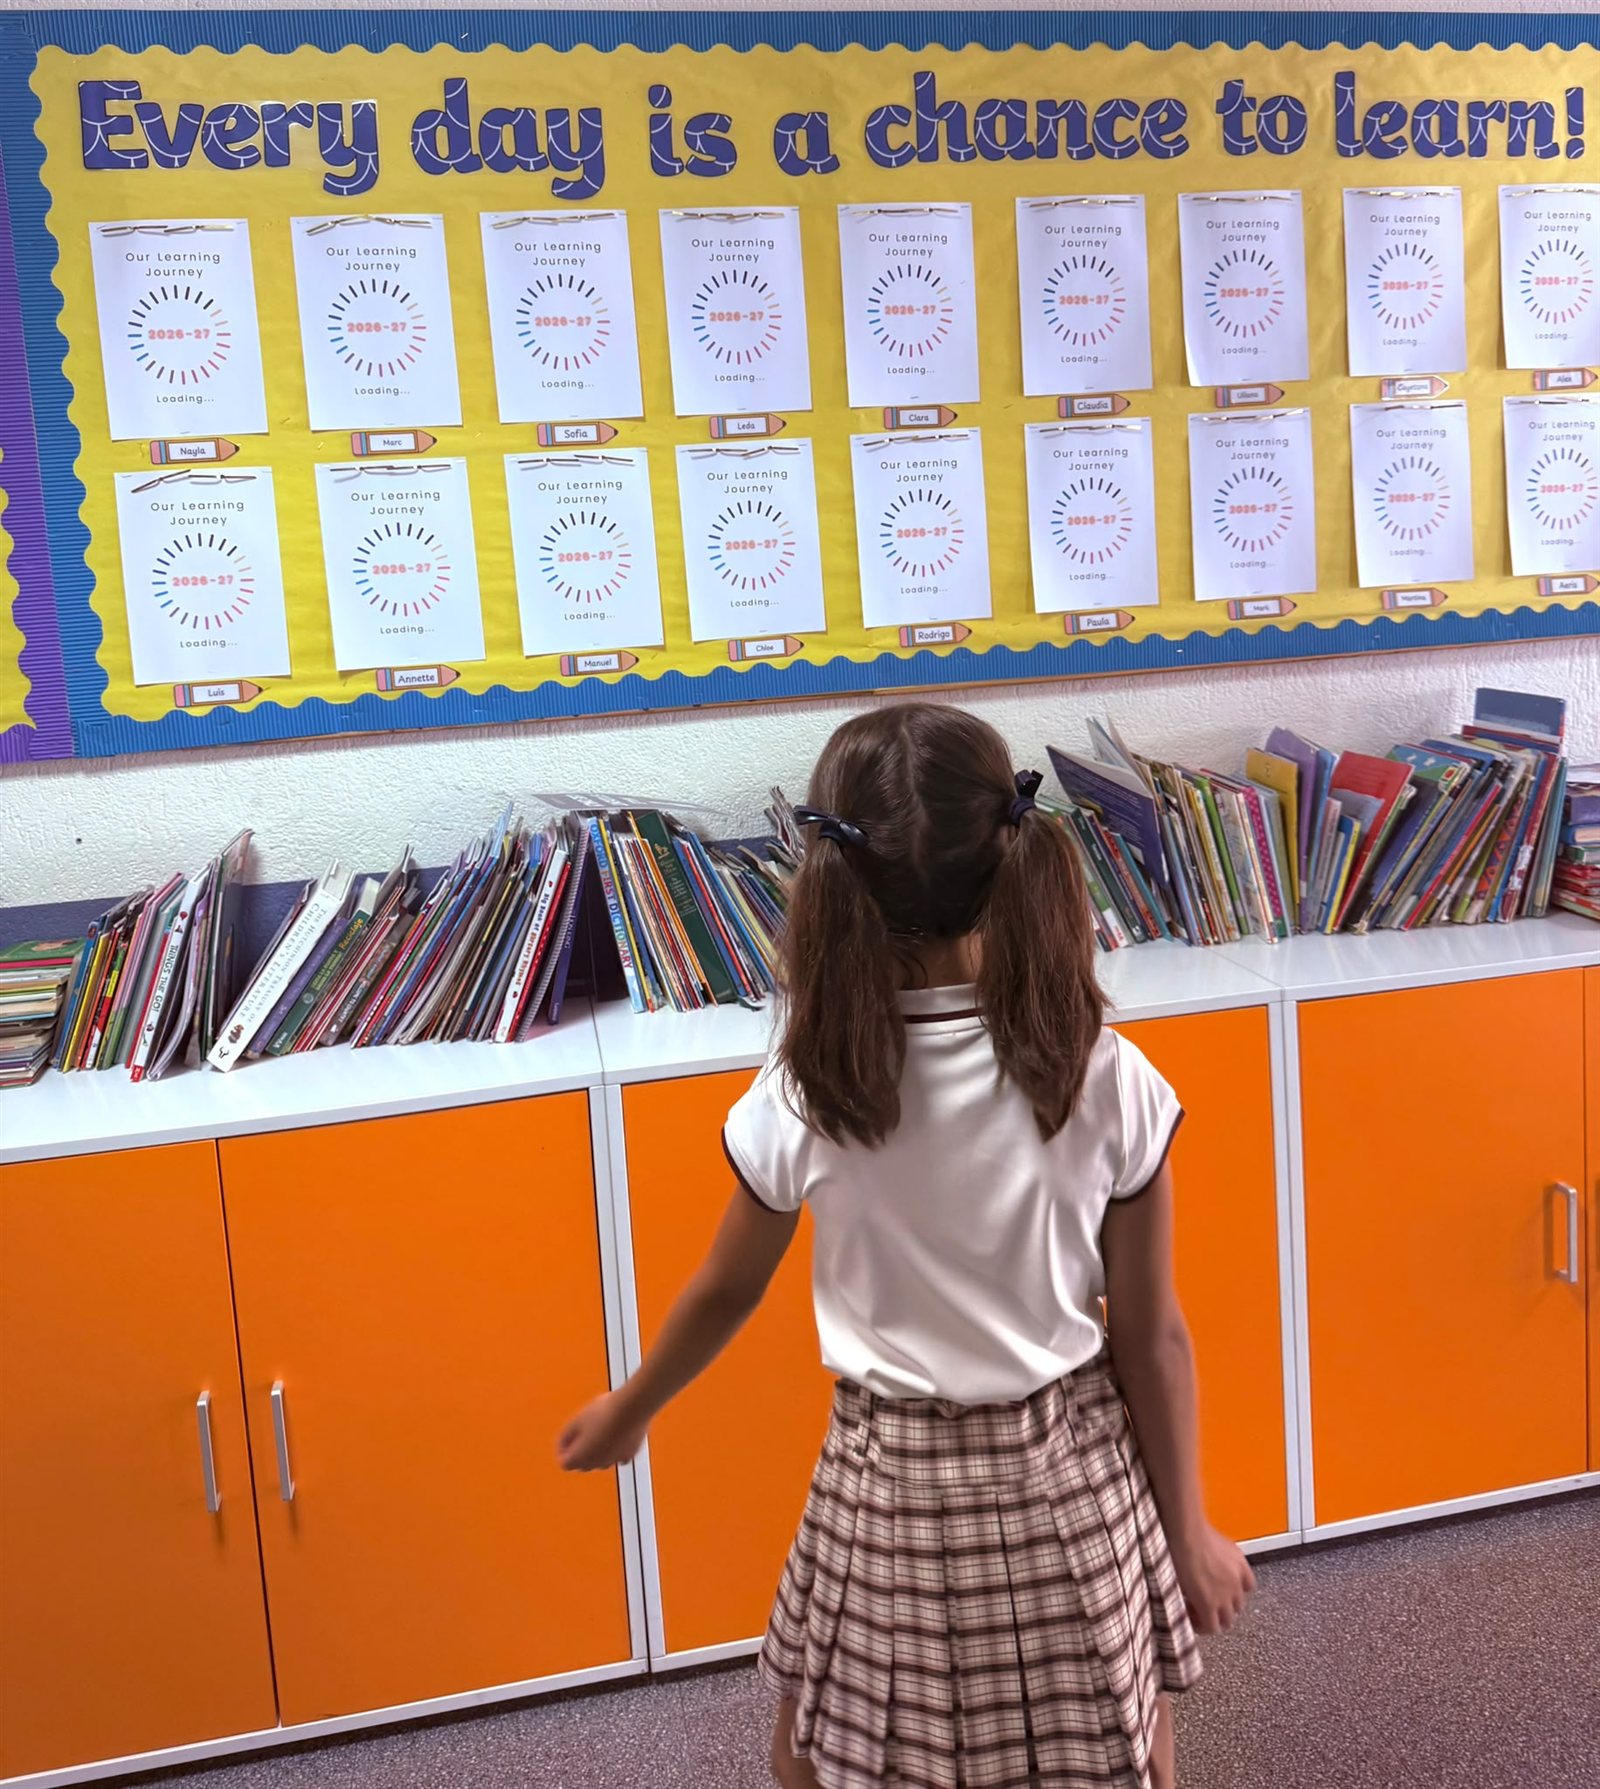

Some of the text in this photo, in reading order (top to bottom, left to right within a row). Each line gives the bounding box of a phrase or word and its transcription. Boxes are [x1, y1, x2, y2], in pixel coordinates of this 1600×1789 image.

[78, 70, 1585, 200] Every day is a chance to learn!
[1370, 214, 1440, 225] Our Learning
[1524, 211, 1591, 221] Our Learning
[1206, 219, 1279, 231] Our Learning
[1538, 224, 1579, 234] Journey
[1045, 225, 1121, 236] Our Learning
[1384, 228, 1427, 238] Journey
[869, 233, 947, 245] Our Learning
[1221, 233, 1266, 244] Journey
[514, 242, 601, 253] Our Learning
[692, 238, 774, 250] Our Learning
[1061, 240, 1107, 249] Journey
[326, 246, 416, 258] Our Learning
[885, 248, 933, 259] Journey
[126, 252, 220, 264] Our Learning
[533, 257, 585, 267] Journey
[709, 253, 759, 263] Journey
[345, 262, 400, 272] Journey
[146, 268, 203, 278] Journey
[1059, 295, 1109, 305] 2026-27
[885, 305, 936, 315] 2026-27
[535, 316, 591, 327] 2026-27
[710, 312, 764, 322] 2026-27
[347, 322, 406, 332] 2026-27
[148, 329, 210, 340] 2026-27
[909, 414, 929, 422] Clara
[737, 421, 756, 430] Leda
[1529, 420, 1595, 430] Our Learning
[564, 429, 588, 439] Sofia
[1376, 429, 1446, 438] Our Learning
[1542, 434, 1583, 442] Journey
[382, 439, 402, 447] Marc
[1216, 438, 1288, 448] Our Learning
[1390, 442, 1433, 450] Journey
[180, 446, 206, 457] Nayla
[1053, 448, 1128, 458] Our Learning
[1231, 452, 1275, 460] Journey
[907, 459, 957, 469] Learning
[1069, 463, 1114, 471] Journey
[735, 470, 787, 480] Learning
[896, 474, 943, 482] Journey
[538, 480, 622, 491] Our Learning
[724, 485, 773, 494] Journey
[351, 491, 440, 501] Our Learning
[556, 496, 607, 504] Journey
[151, 501, 244, 512] Our Learning
[370, 504, 424, 516] Journey
[170, 514, 227, 526] Journey
[1067, 516, 1116, 526] 2026-27
[897, 527, 947, 538] 2026-27
[726, 539, 778, 550] 2026-27
[558, 551, 613, 562] 2026-27
[372, 563, 430, 574] 2026-27
[173, 575, 233, 586] 2026-27
[1086, 617, 1109, 627] Paula
[918, 629, 950, 642] Rodrigo
[584, 658, 612, 668] Manuel
[398, 672, 435, 684] Annette
[591, 824, 632, 968] OXFORD FIRST DICTIONARY
[315, 909, 327, 925] THE
[338, 918, 364, 950] Reciclaje
[281, 926, 316, 972] HUTCHINSON
[241, 961, 281, 1018] LITERATURE
